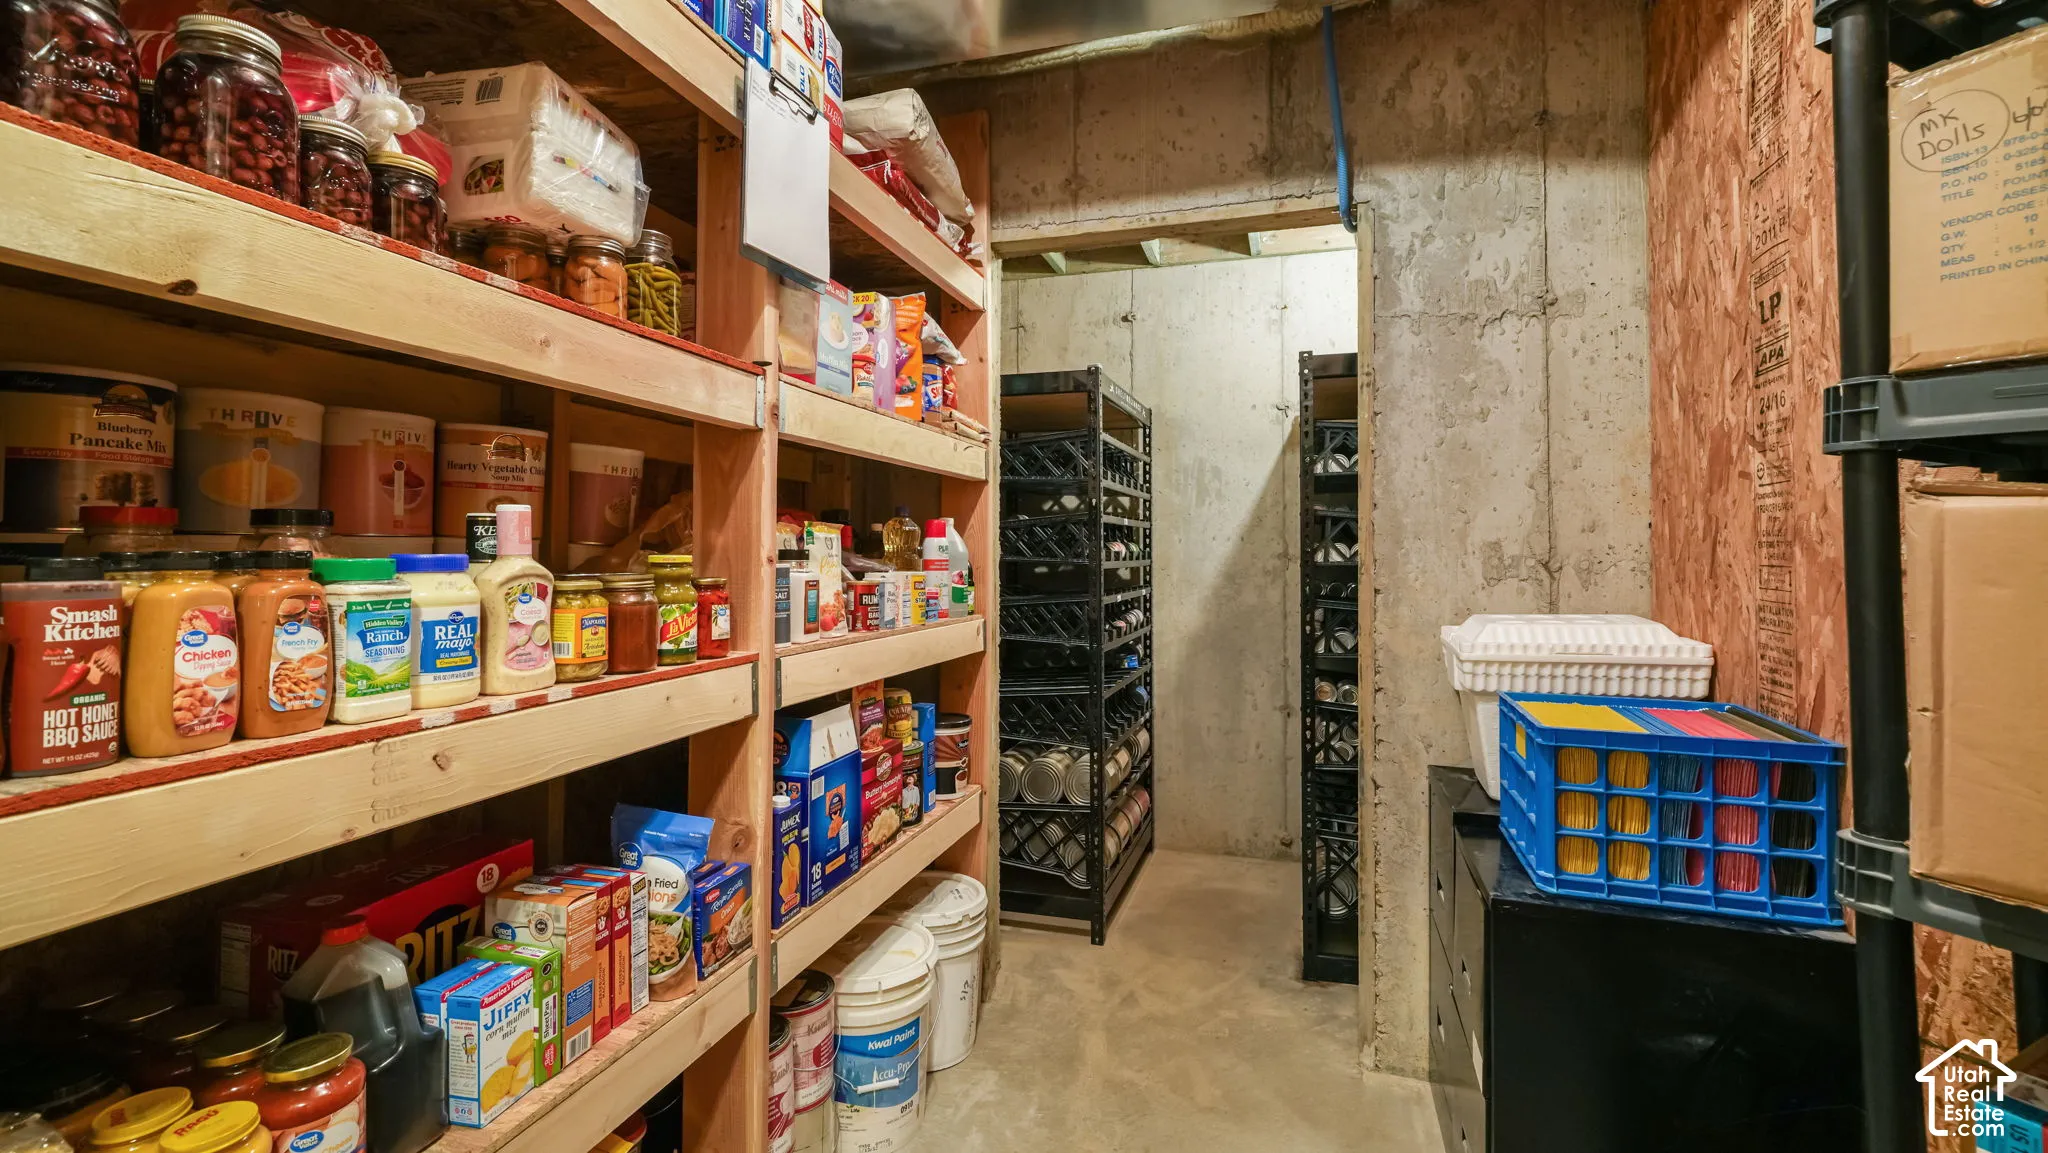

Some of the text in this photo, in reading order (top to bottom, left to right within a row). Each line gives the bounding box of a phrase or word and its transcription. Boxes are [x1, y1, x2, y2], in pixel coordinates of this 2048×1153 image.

[1920, 108, 1960, 138] MK
[1918, 123, 1985, 160] Dolls
[1941, 145, 1988, 165] ISBN-13
[1941, 188, 1975, 203] TITLE
[1941, 200, 2036, 229] VENDOR CODE
[1941, 243, 1965, 256] QTY
[1941, 254, 1976, 267] MEAS
[1941, 265, 1996, 283] PRINTED
[1999, 262, 2012, 271] IN
[1759, 291, 1782, 325] LP
[1759, 345, 1785, 367] APA
[1759, 390, 1786, 416] 24/16
[207, 407, 296, 428] THRIVE
[97, 421, 154, 438] Blueberry
[69, 432, 167, 454] Pancake Mix
[447, 460, 528, 474] Hearty Vegetable
[491, 474, 510, 482] Soup
[50, 605, 118, 625] Smash
[43, 622, 120, 643] Kitchen
[365, 619, 404, 629] Hidden Valley
[434, 624, 474, 640] REAL
[281, 638, 318, 647] French Fry
[366, 630, 404, 644] Ranch
[435, 638, 472, 651] mayo
[182, 649, 231, 663] Chicken
[365, 646, 405, 658] SEASONING
[73, 693, 106, 704] ORGANIC
[43, 701, 119, 729] HOT HONEY
[42, 719, 118, 748] BBQ SAUCE
[865, 786, 883, 799] Buttery
[781, 811, 801, 832] JUMEX
[618, 848, 638, 861] Great
[622, 857, 638, 867] Value
[480, 866, 494, 883] 18
[811, 862, 822, 882] 18
[654, 879, 679, 889] Fried
[494, 928, 512, 937] Great
[395, 904, 482, 985] RITZ
[267, 945, 299, 973] RITZ
[483, 984, 510, 1007] America's
[510, 971, 533, 990] Favorite
[483, 989, 532, 1031] JIFFY
[485, 1007, 530, 1041] corn muffin
[501, 1025, 518, 1041] mix
[868, 1026, 916, 1051] Kwal Paint
[900, 1099, 914, 1114] 0910
[293, 1133, 319, 1147] Great
